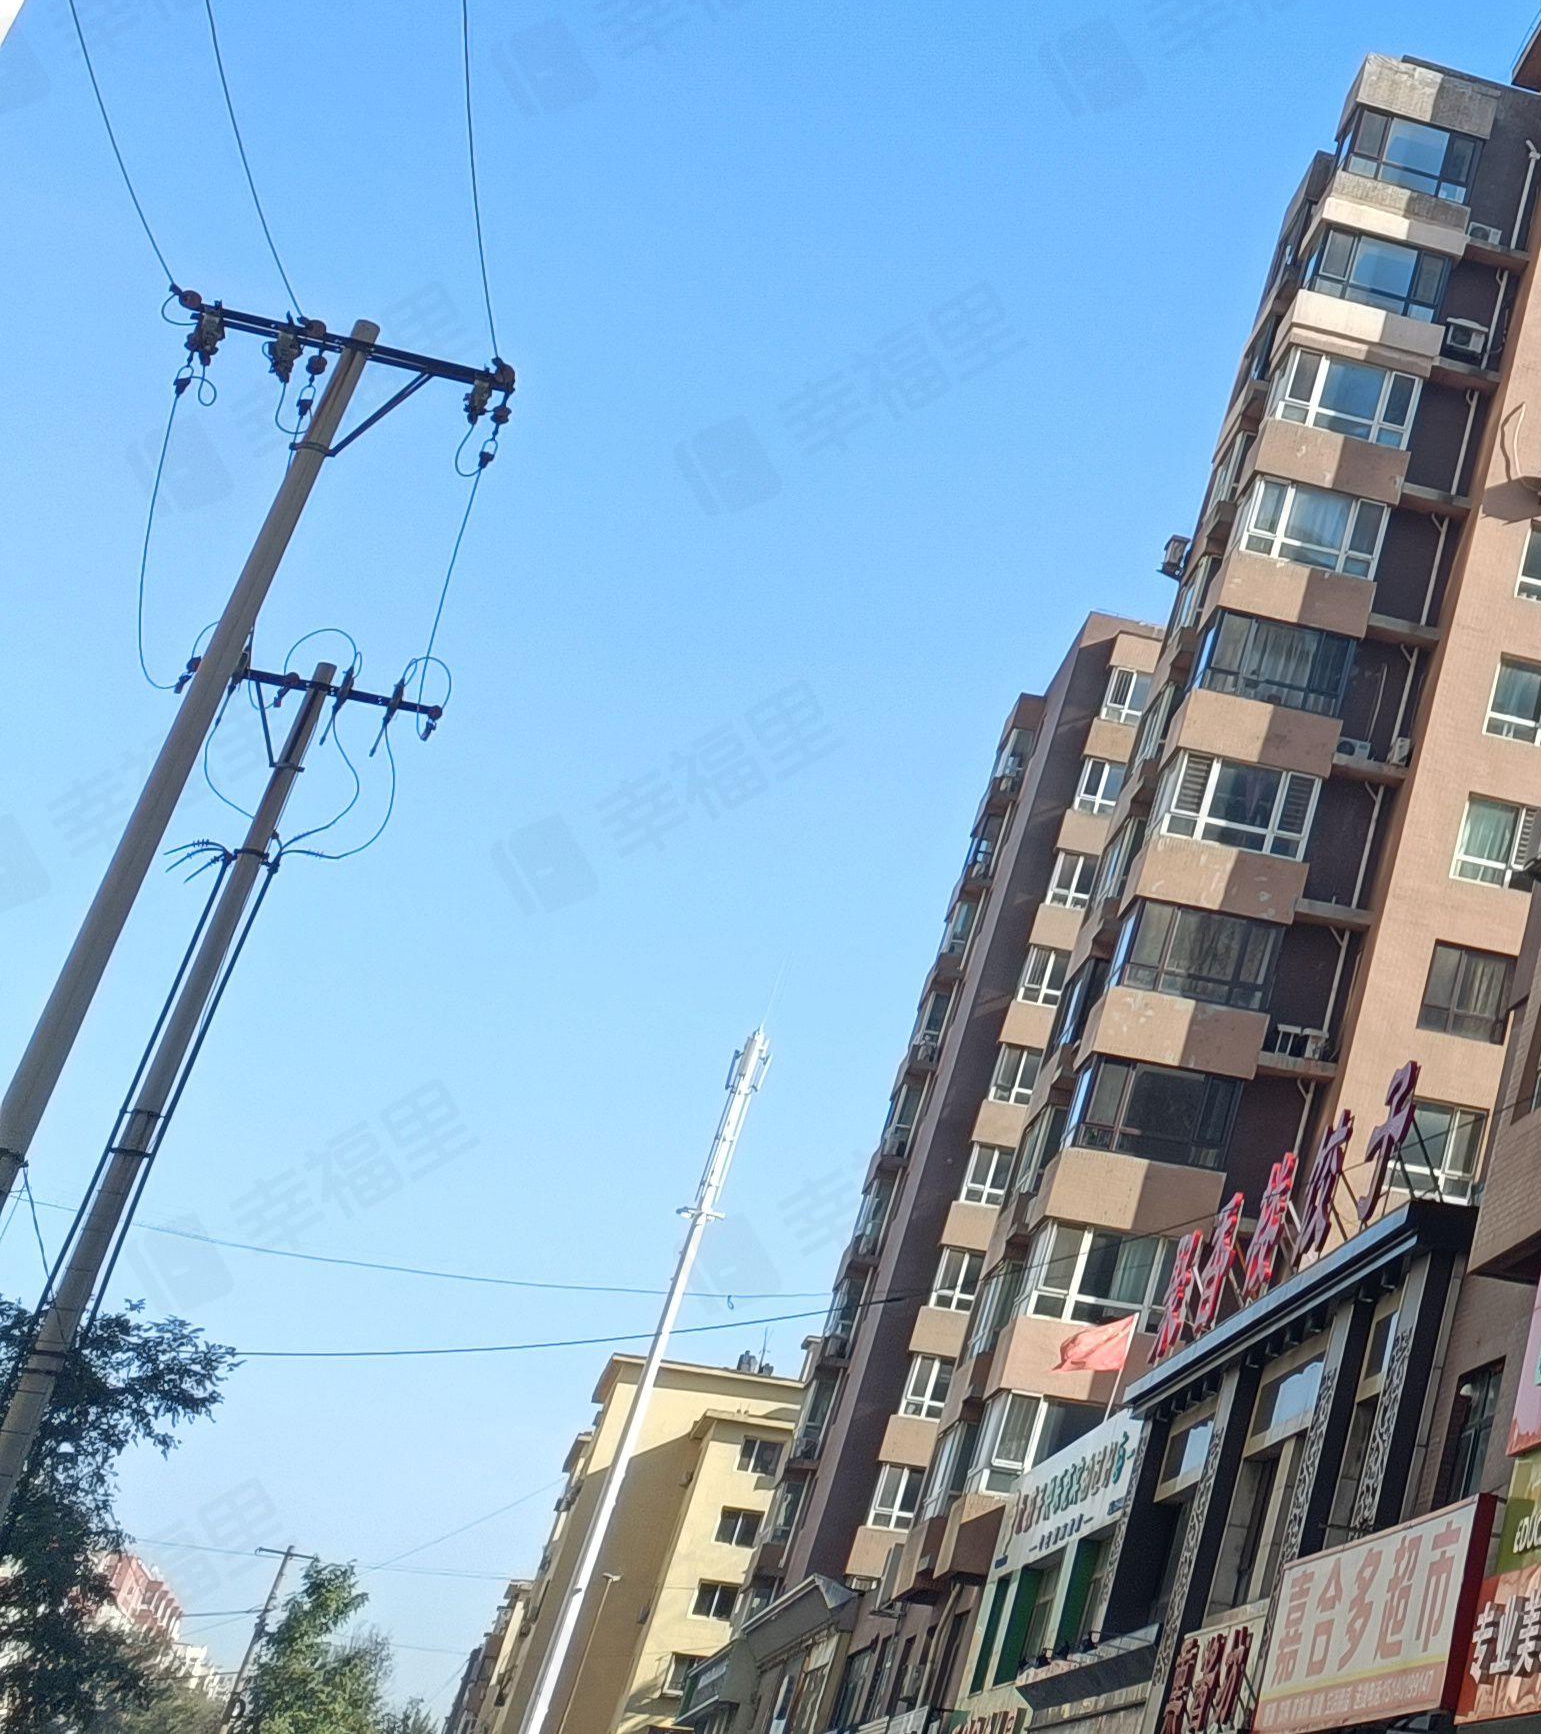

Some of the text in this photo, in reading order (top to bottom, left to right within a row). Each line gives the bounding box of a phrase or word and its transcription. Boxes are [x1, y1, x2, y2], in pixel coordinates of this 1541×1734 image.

[1271, 1520, 1462, 1687] 嘉合多超市
